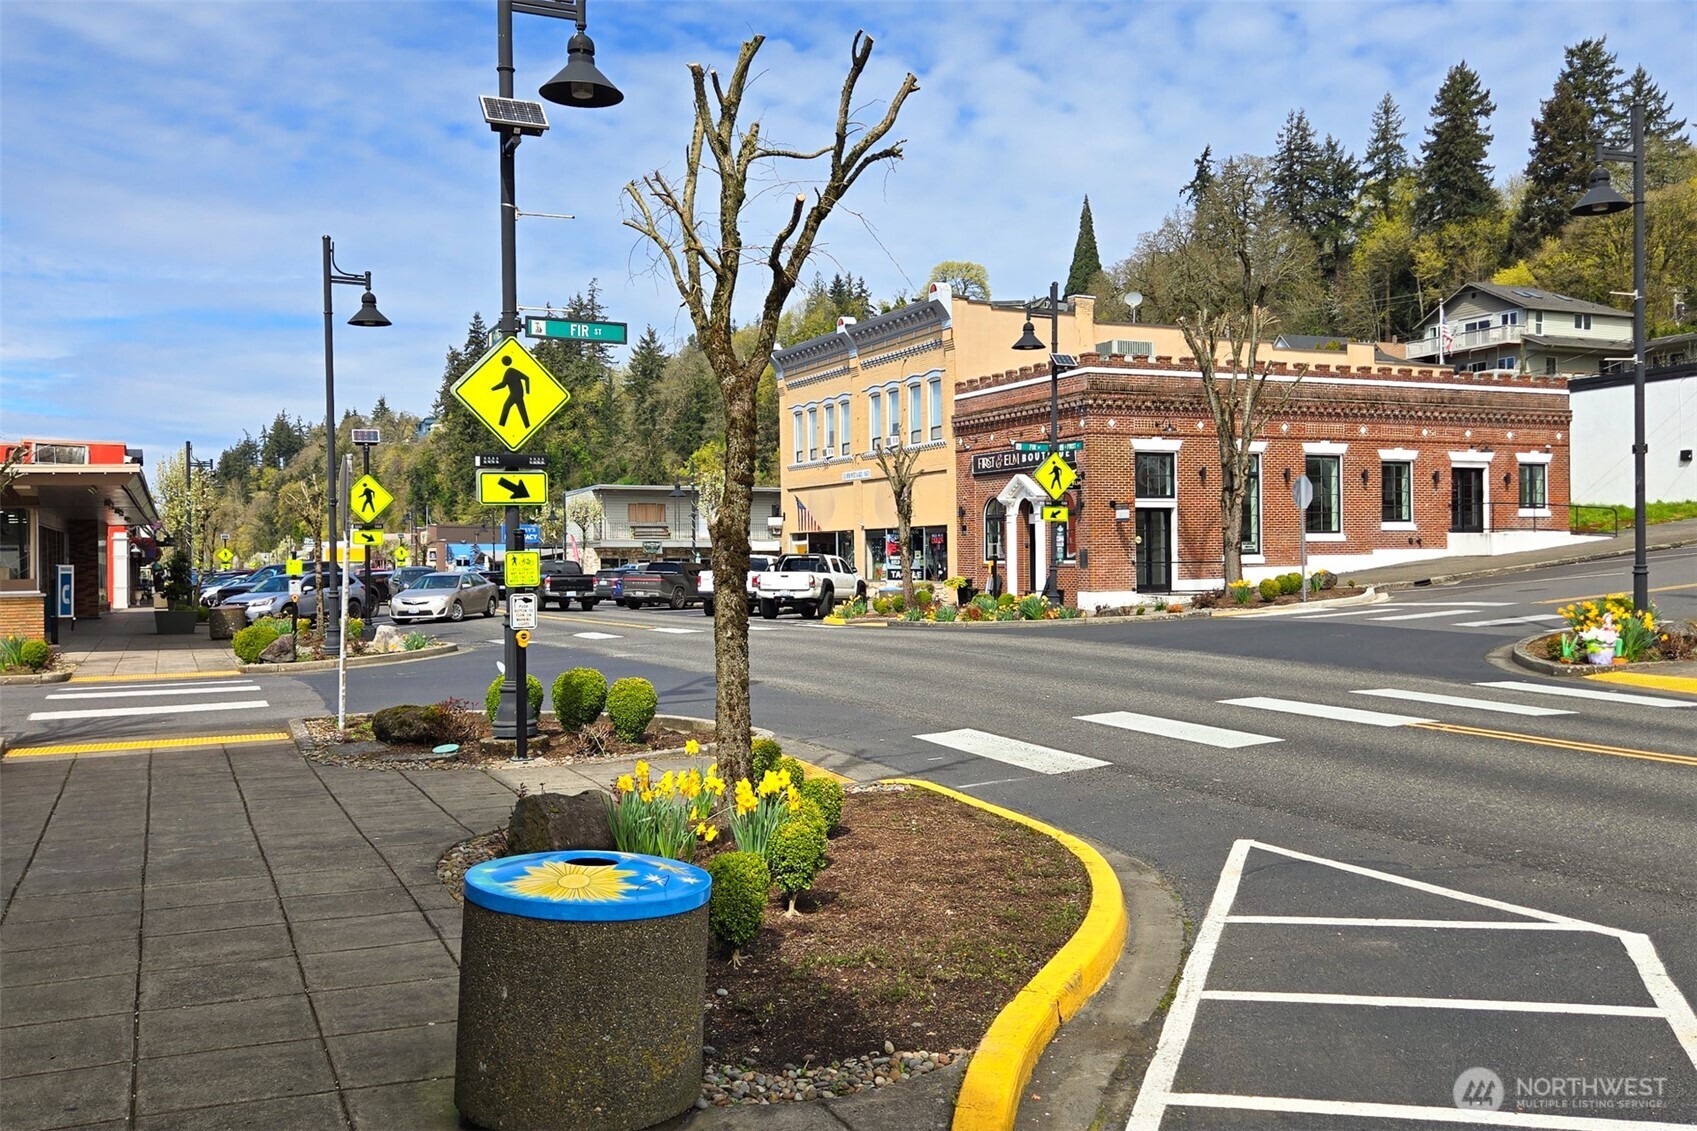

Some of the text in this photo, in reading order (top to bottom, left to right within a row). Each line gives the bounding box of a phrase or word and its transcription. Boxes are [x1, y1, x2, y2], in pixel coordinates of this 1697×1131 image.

[570, 323, 589, 337] FIR
[995, 454, 1003, 468] &
[1004, 453, 1020, 466] ELM
[1022, 451, 1070, 463] BOUTUE
[890, 570, 922, 578] TALE
